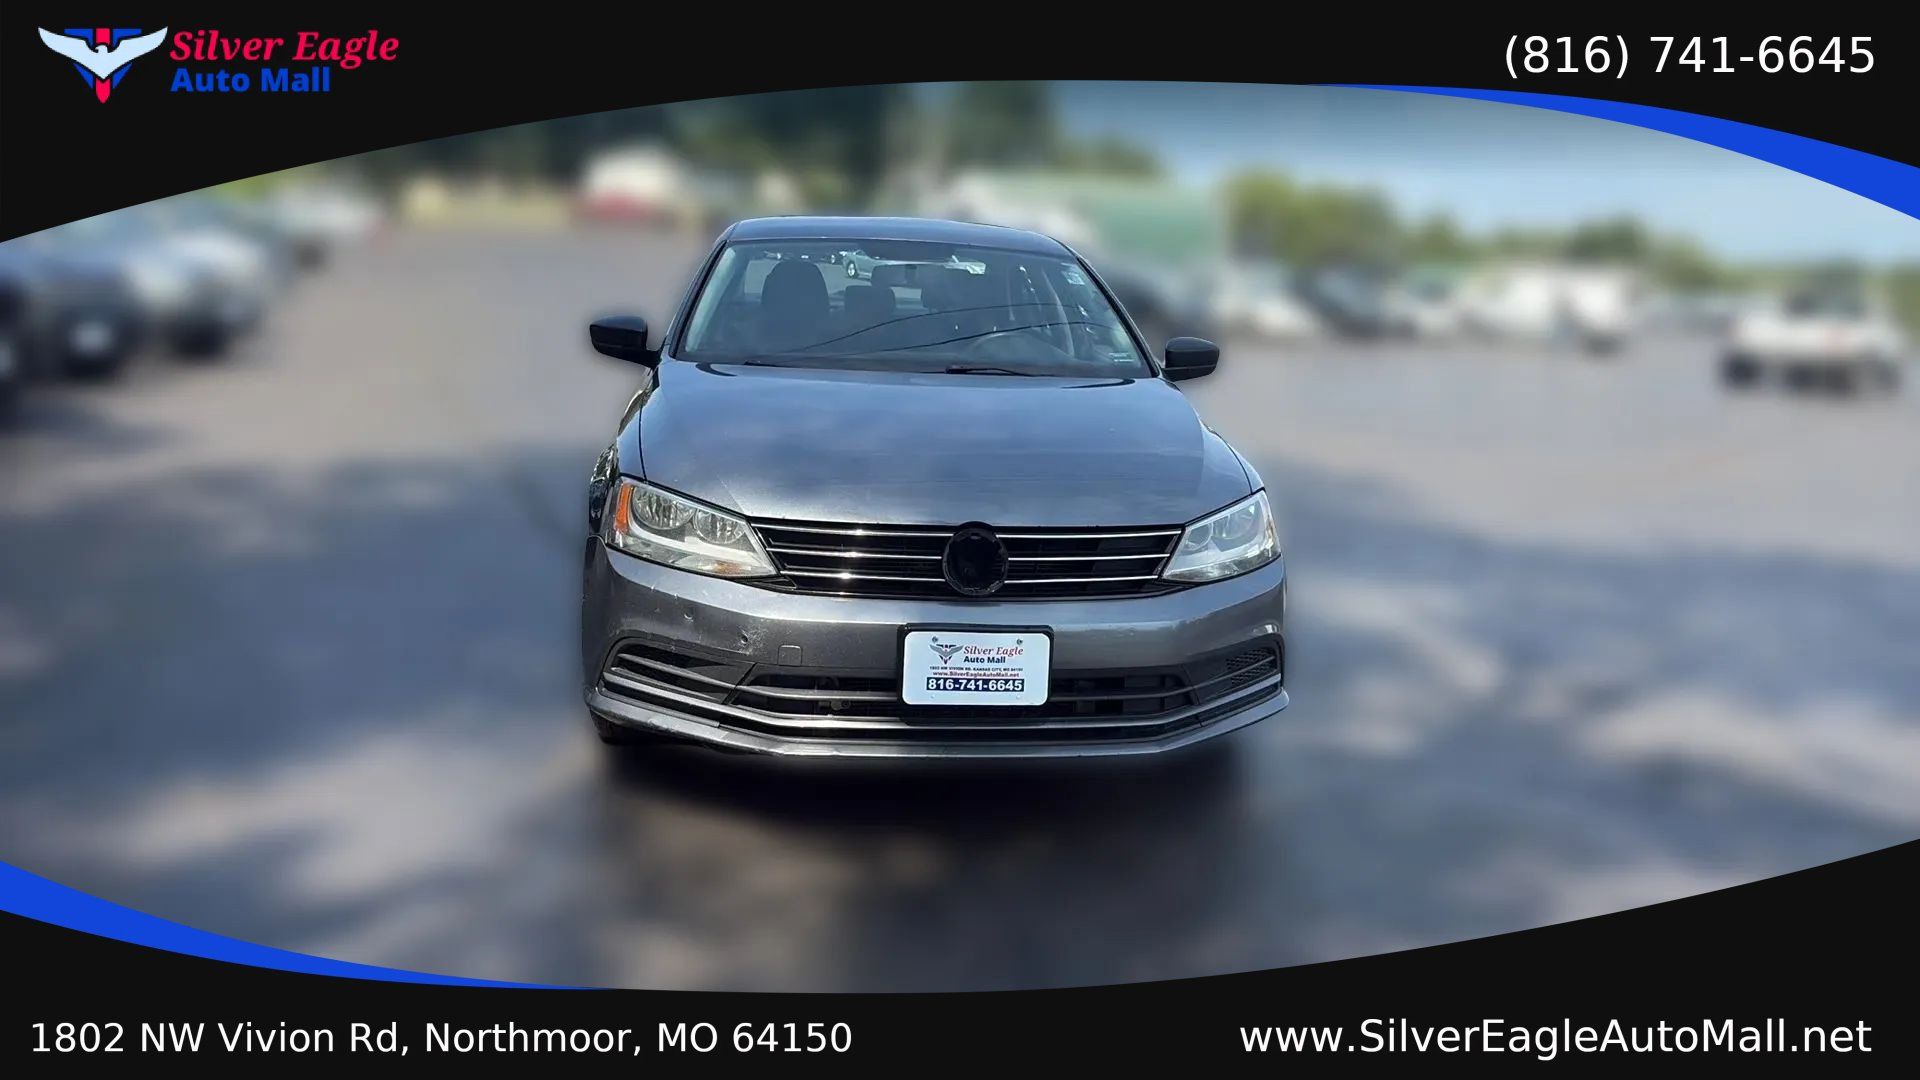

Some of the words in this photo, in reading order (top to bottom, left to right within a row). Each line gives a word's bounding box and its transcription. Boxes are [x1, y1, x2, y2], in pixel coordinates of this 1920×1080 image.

[963, 646, 994, 656] Silver
[996, 646, 1024, 657] Eagle
[987, 656, 1006, 664] Mall
[928, 678, 1023, 691] 816-741-6645
